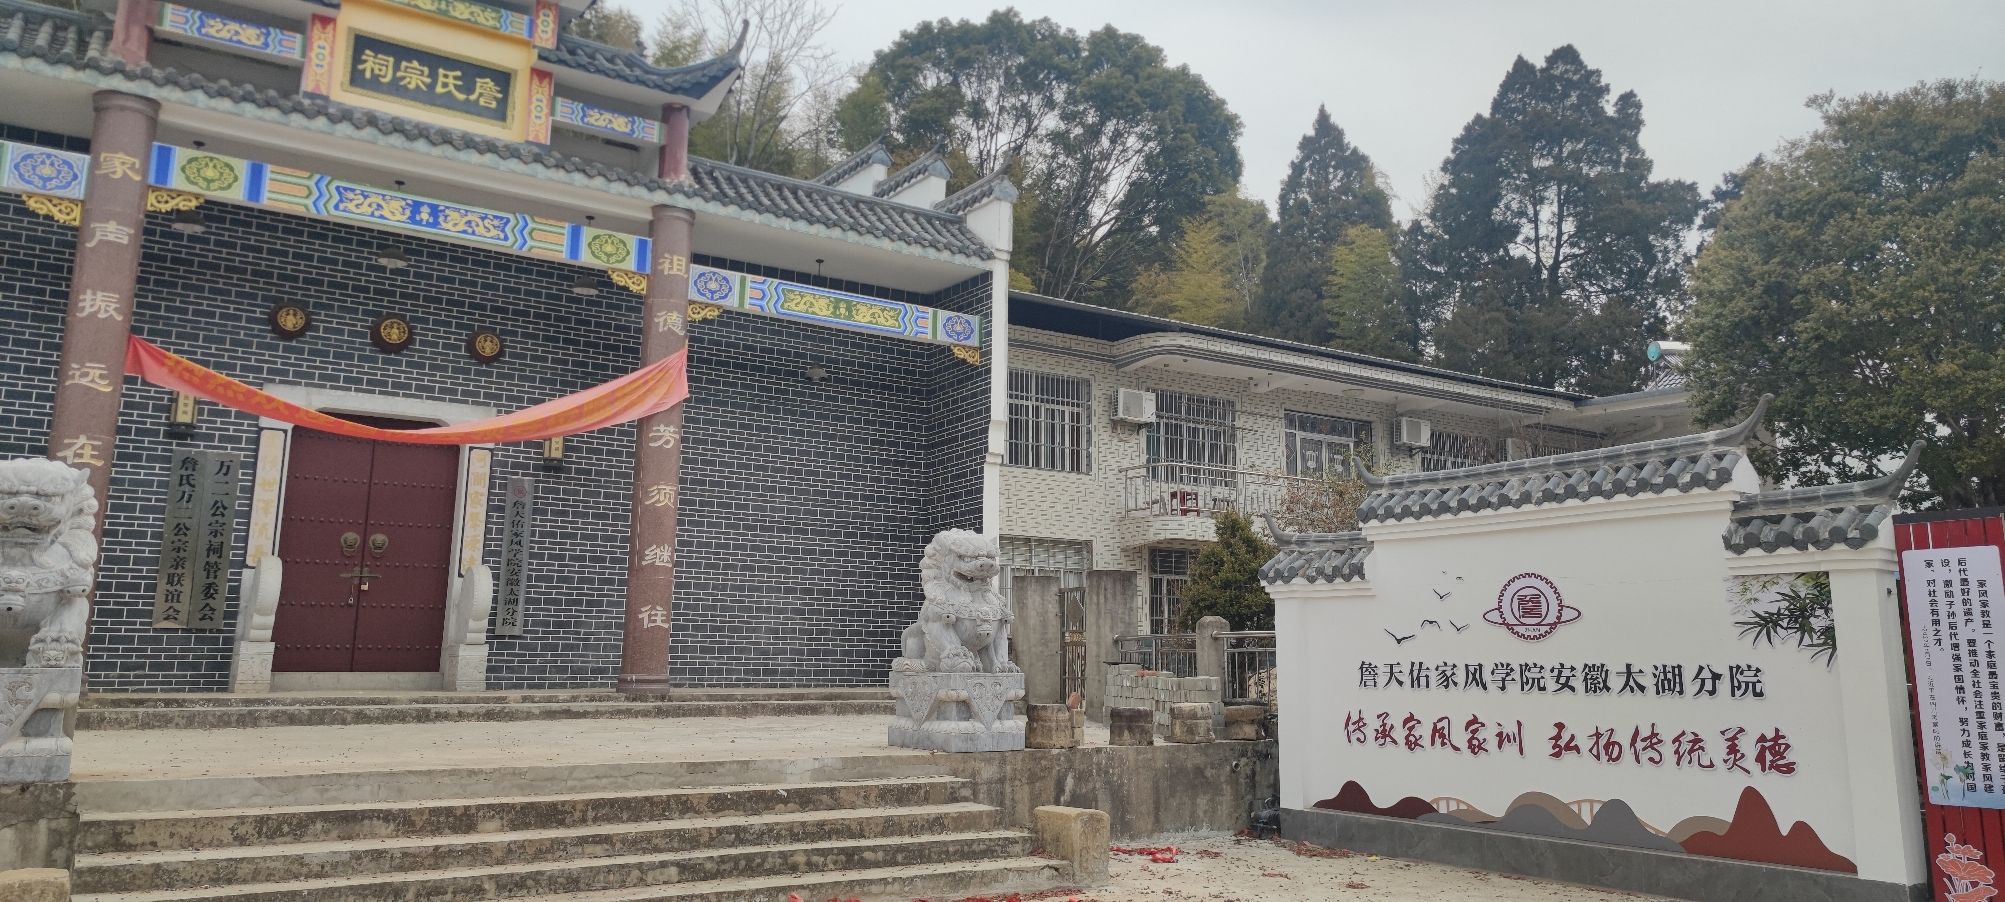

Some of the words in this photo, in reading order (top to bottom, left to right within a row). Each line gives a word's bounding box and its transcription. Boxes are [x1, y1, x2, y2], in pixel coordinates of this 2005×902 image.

[357, 49, 504, 110] 詹氏宗祠
[638, 253, 689, 630] 祖德芳须继往
[161, 456, 199, 622] 詹氏万二公宗亲联谊会
[198, 459, 234, 623] 万二公宗祠管委会
[501, 500, 526, 628] 詹天佑家风学院安徽太湖分院
[1344, 708, 1525, 757] 传承家风家训
[1548, 721, 1798, 776] 弘扬传统美德
[1357, 660, 1766, 699] 詹天佑家风学院安徽太湖分院
